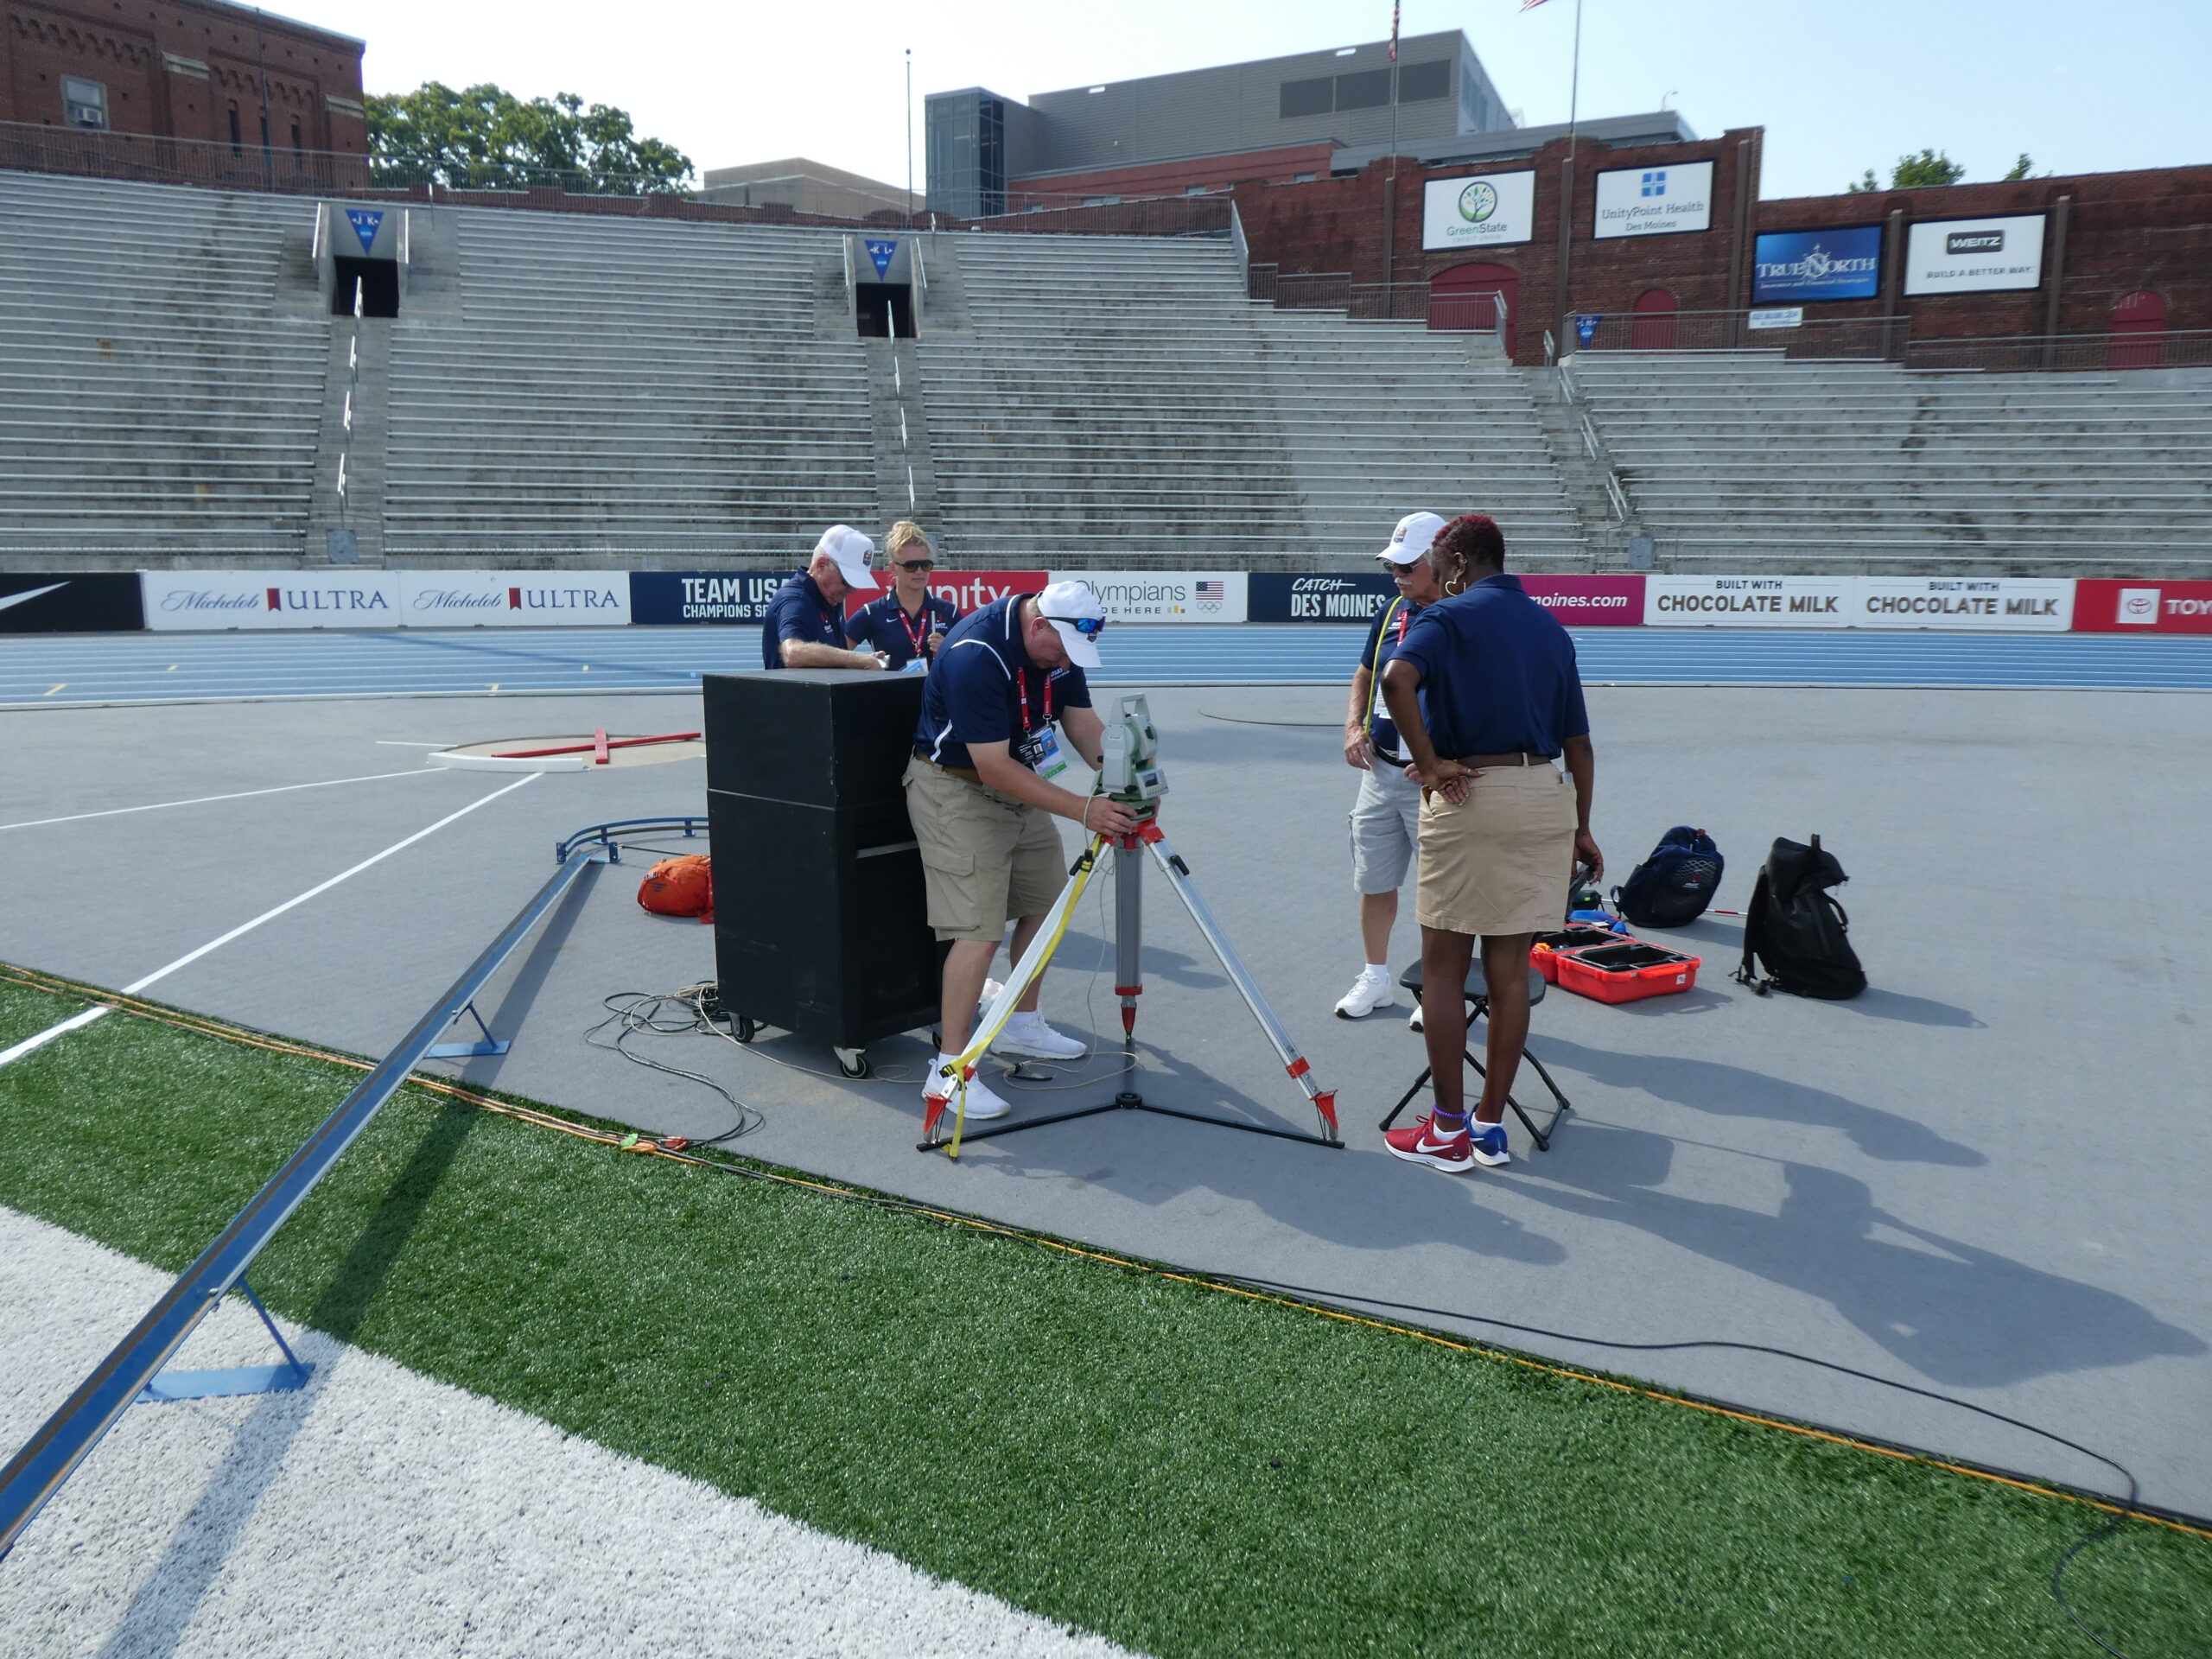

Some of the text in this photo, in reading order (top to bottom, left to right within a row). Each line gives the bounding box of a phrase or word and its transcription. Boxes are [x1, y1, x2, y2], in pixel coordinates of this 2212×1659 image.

[1602, 200, 1705, 219] UnityPoint Health
[1446, 222, 1508, 236] GreenState
[1625, 220, 1677, 231] Des Moines
[1950, 236, 2002, 249] WEITZ
[1927, 270, 1956, 278] BUILD
[1969, 267, 2005, 276] BETTER
[681, 578, 741, 603] TEAM
[1292, 577, 1356, 591] CATCH
[1715, 580, 1783, 589] BUILT WITH
[1928, 582, 2000, 592] BUILT WITH
[161, 589, 389, 612] Michelob ULTRA
[413, 589, 620, 610] Michelob ULTRA
[1291, 594, 1386, 617] DES MOINES
[1529, 593, 1628, 607] moines.com
[1657, 594, 1839, 613] CHOCOLATE MILK
[1866, 595, 2059, 616] CHOCOLATE MILK
[683, 604, 751, 618] CHAMPIONS
[2164, 599, 2212, 615] TOY
